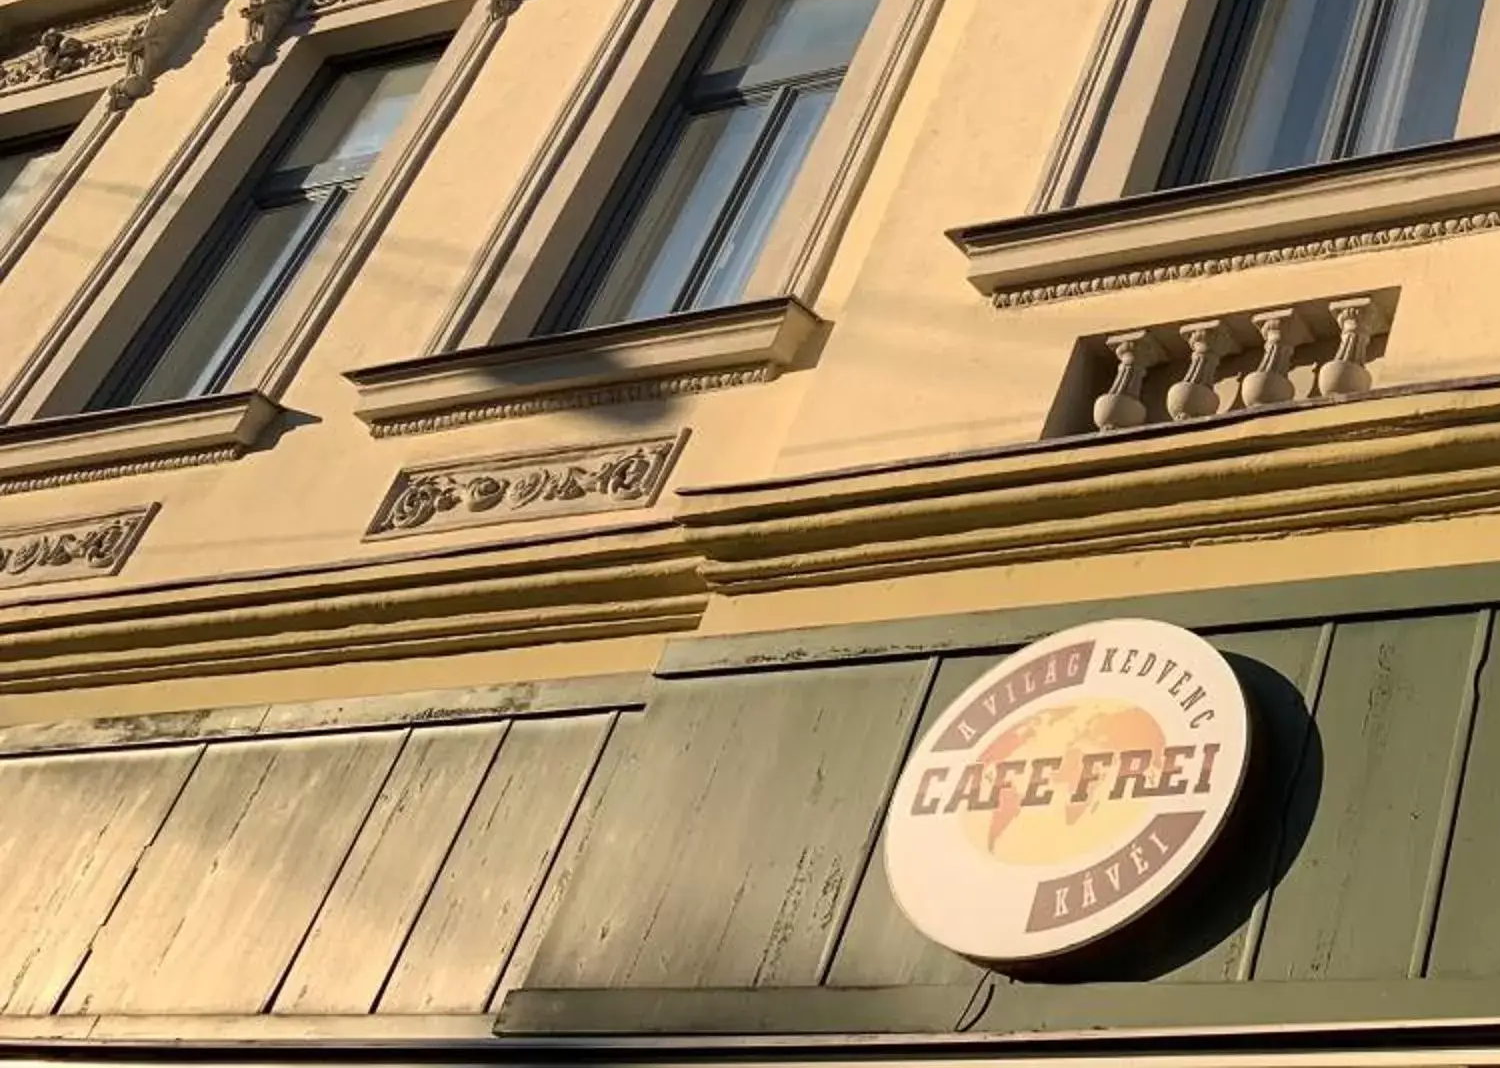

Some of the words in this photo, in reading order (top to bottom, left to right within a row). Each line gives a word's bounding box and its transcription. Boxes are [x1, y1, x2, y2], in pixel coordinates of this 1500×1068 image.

[957, 724, 977, 743] A
[983, 649, 1081, 718] VILÁG
[1100, 646, 1216, 730] KEDVENC
[911, 758, 1063, 816] CAFE
[1070, 743, 1221, 803] FREI
[1053, 833, 1170, 918] KÁVÉI
